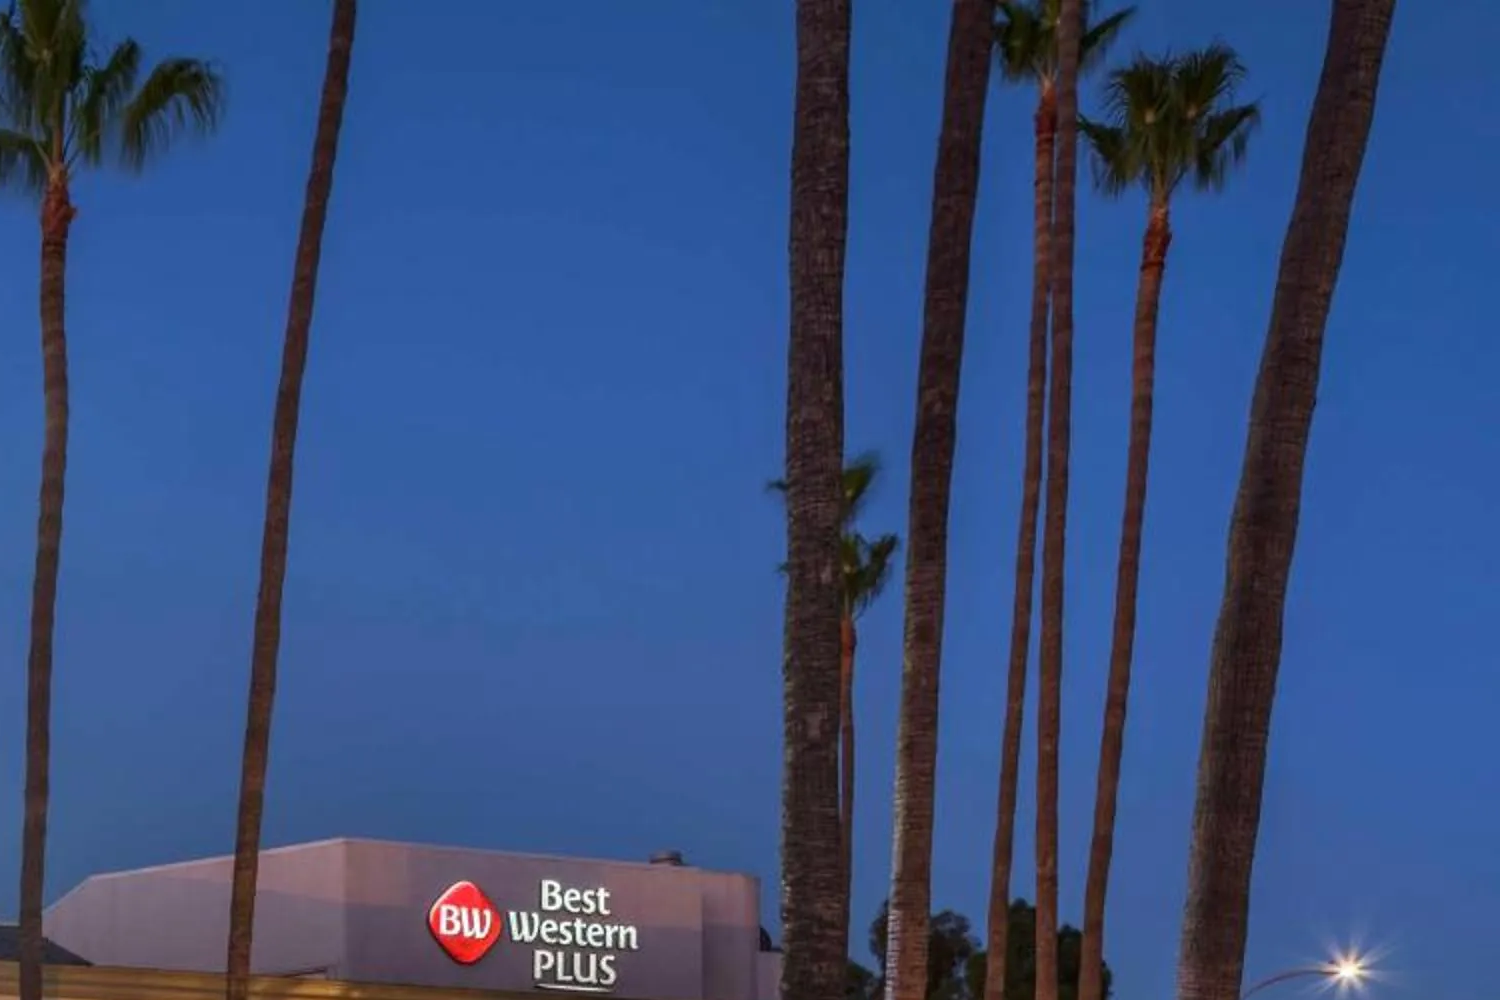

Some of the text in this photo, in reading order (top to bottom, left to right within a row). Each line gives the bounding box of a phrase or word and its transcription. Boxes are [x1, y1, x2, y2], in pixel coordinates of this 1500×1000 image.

[541, 879, 610, 915] Best
[439, 904, 491, 939] BW
[509, 911, 638, 949] Western
[533, 950, 616, 985] PLUS
